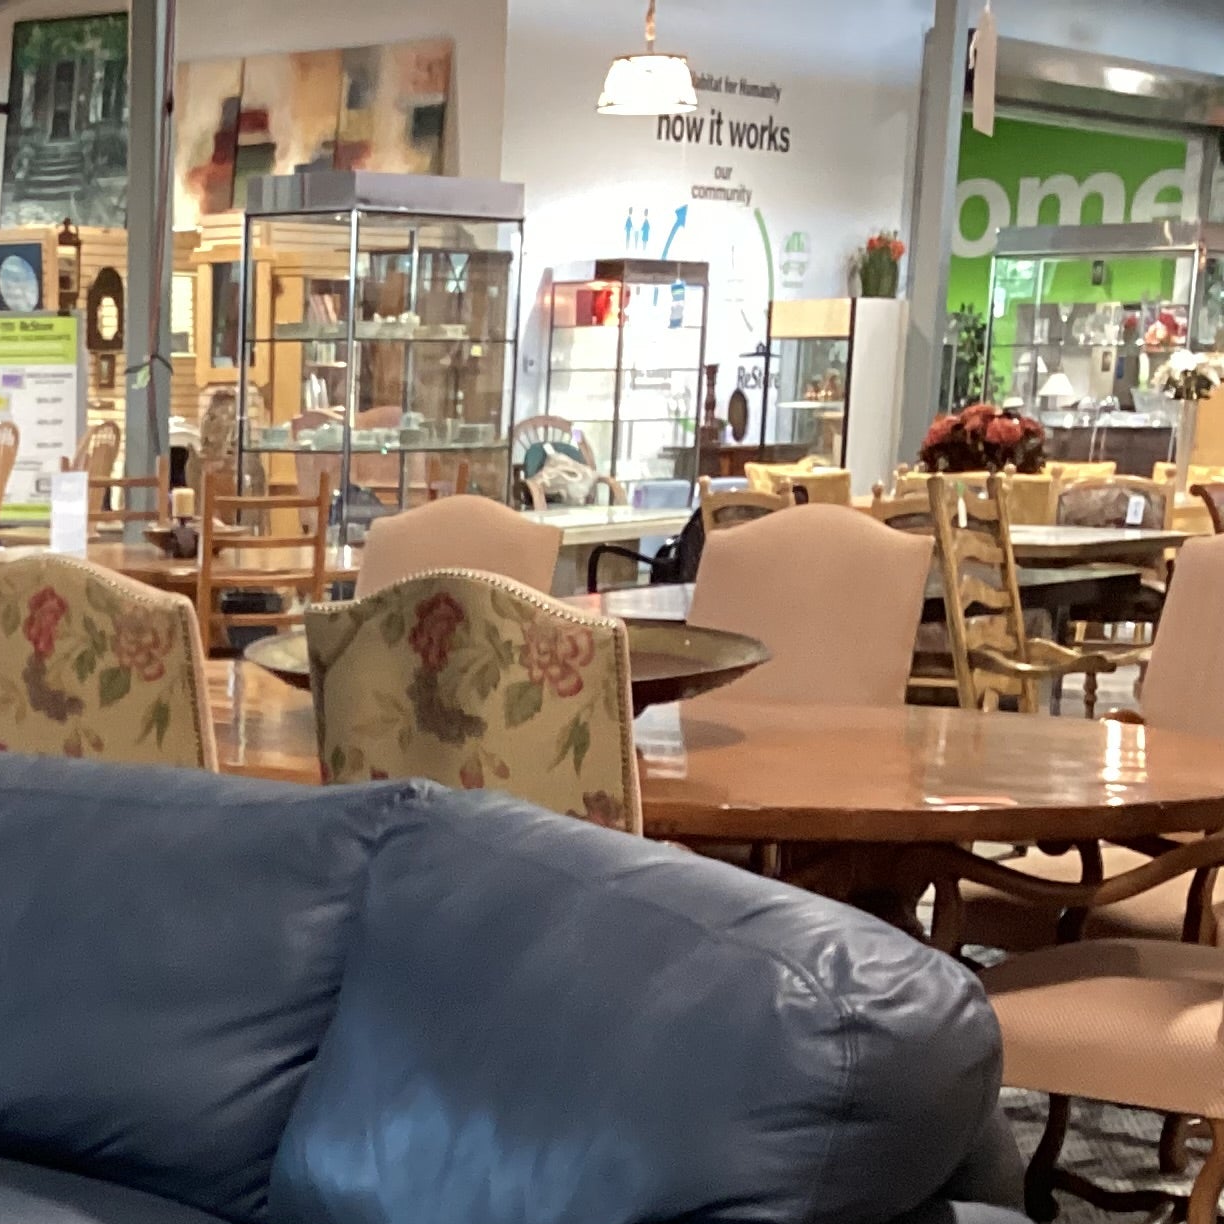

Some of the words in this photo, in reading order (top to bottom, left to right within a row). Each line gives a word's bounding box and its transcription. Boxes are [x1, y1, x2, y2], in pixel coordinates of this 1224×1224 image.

[725, 75, 738, 94] for
[739, 78, 782, 104] Humanity
[709, 108, 724, 146] it
[729, 114, 791, 153] works
[714, 166, 733, 180] our
[691, 184, 753, 207] community
[737, 365, 781, 389] ReStre
